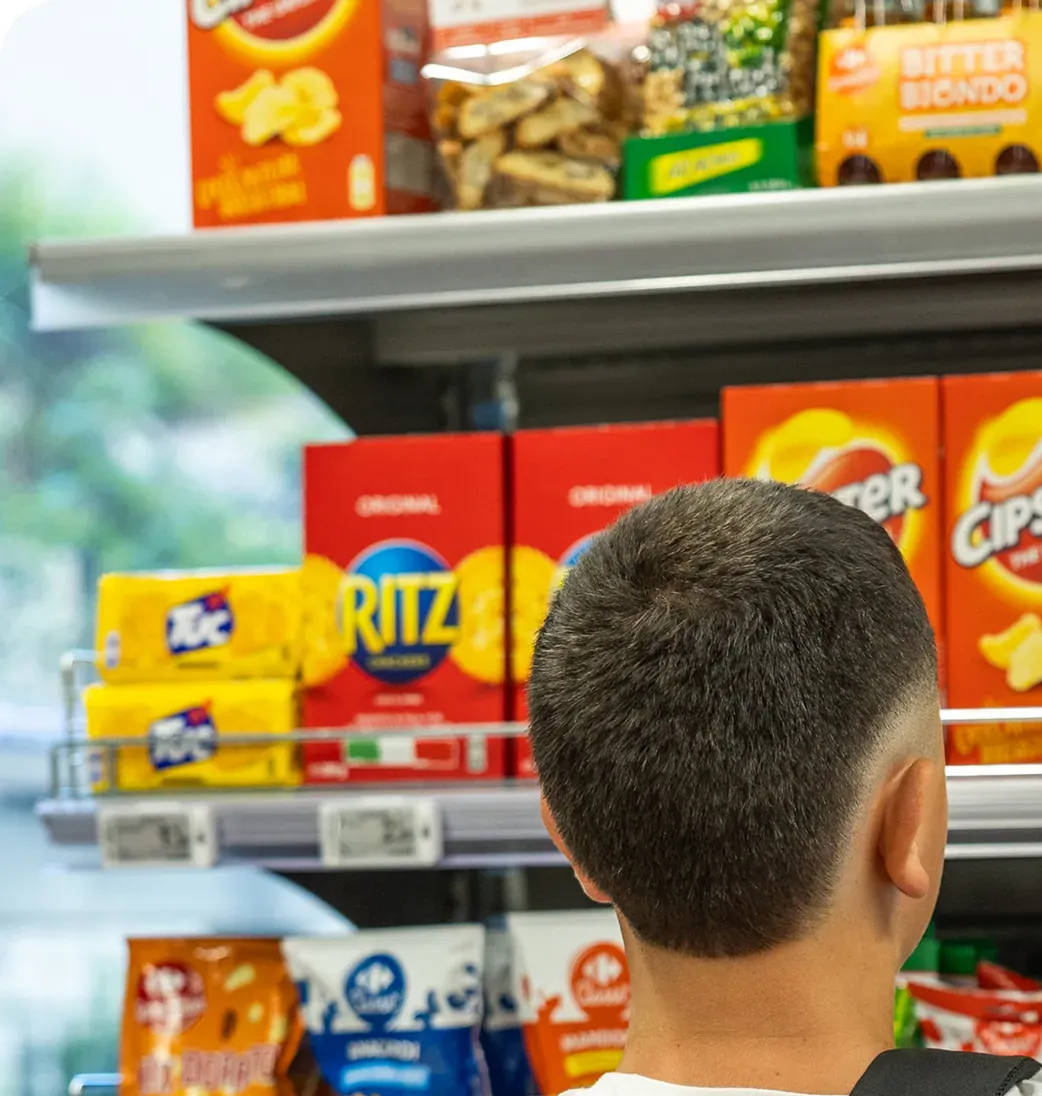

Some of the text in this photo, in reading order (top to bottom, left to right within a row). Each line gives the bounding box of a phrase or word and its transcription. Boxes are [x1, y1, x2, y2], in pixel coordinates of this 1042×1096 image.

[901, 40, 1024, 78] BITTER
[901, 74, 1027, 110] BIONDO
[1010, 547, 1040, 570] THE
[340, 571, 460, 654] RITZ
